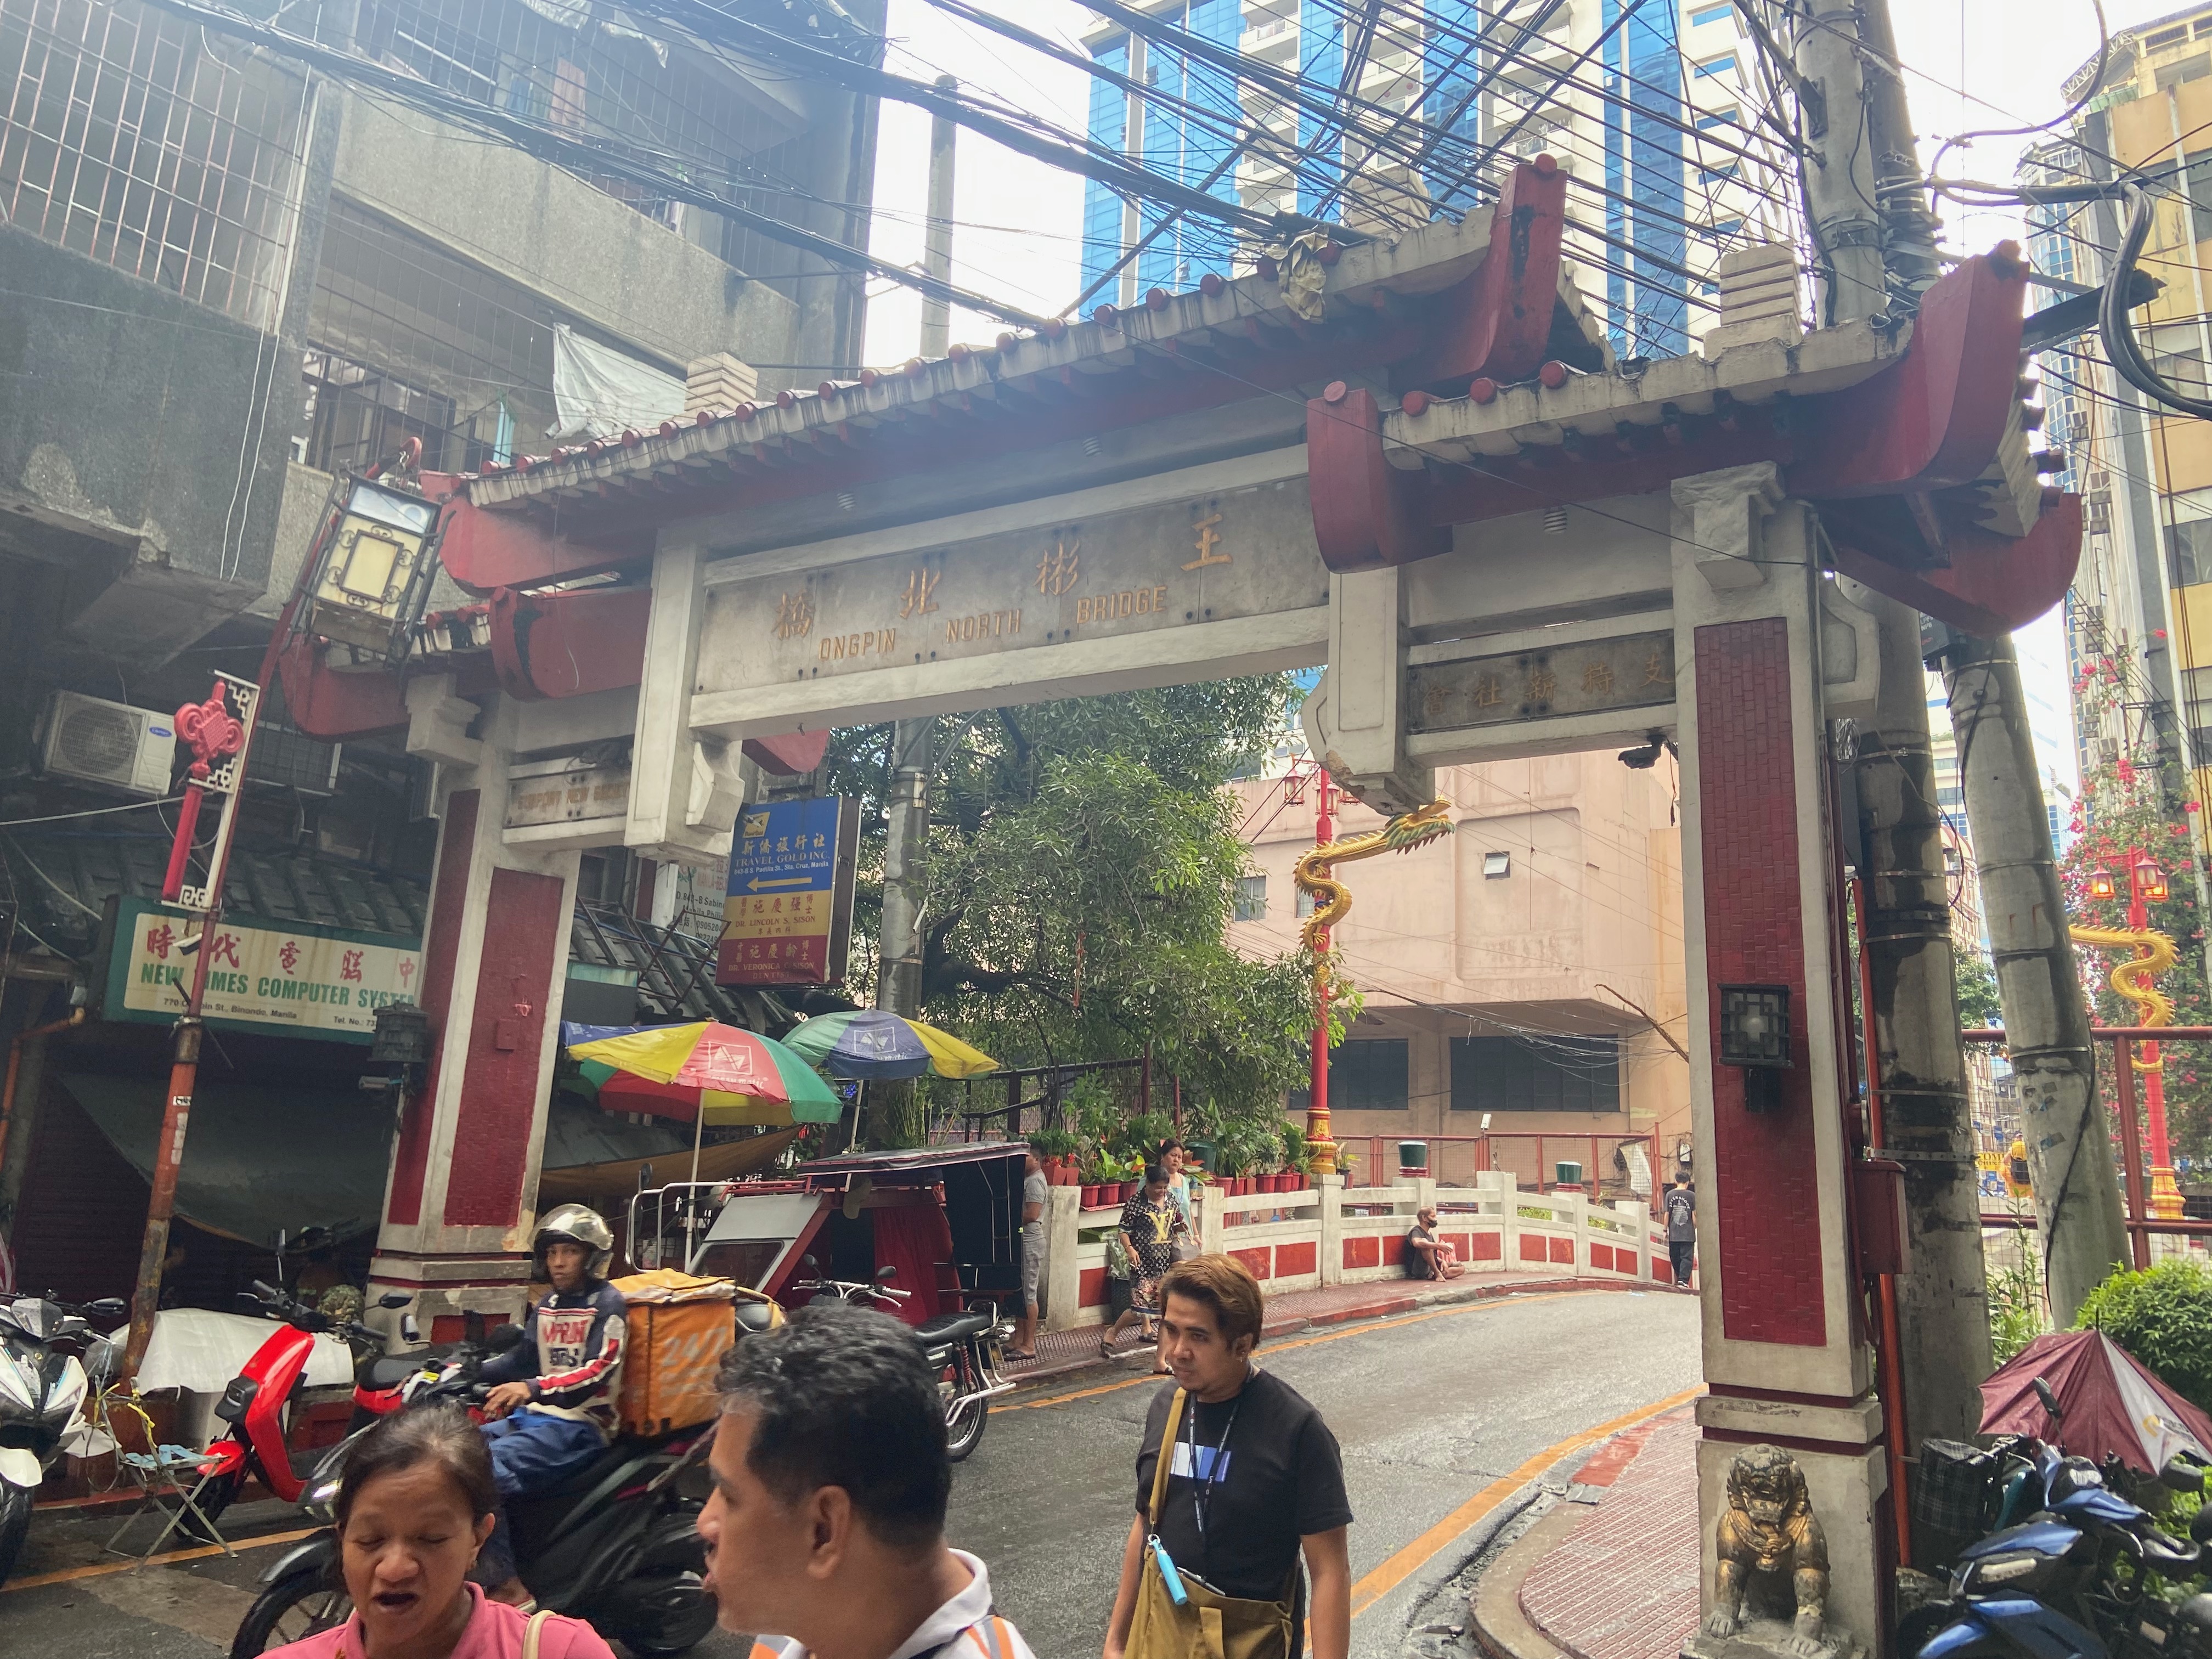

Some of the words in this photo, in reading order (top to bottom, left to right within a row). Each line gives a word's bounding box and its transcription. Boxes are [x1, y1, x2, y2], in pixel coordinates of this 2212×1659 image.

[819, 628, 896, 662] ONGPIN
[945, 609, 1022, 644] NORTH
[1075, 585, 1167, 624] BRIDGE
[566, 787, 590, 804] NEW
[736, 856, 775, 867] TRAVEL
[777, 851, 806, 863] GOLD
[750, 918, 780, 926] LINCOLN
[141, 963, 184, 986] NEW
[196, 969, 249, 995] IMES
[257, 977, 350, 1006] COMPUTER
[164, 997, 179, 1006] 770
[271, 1008, 297, 1019] Manila
